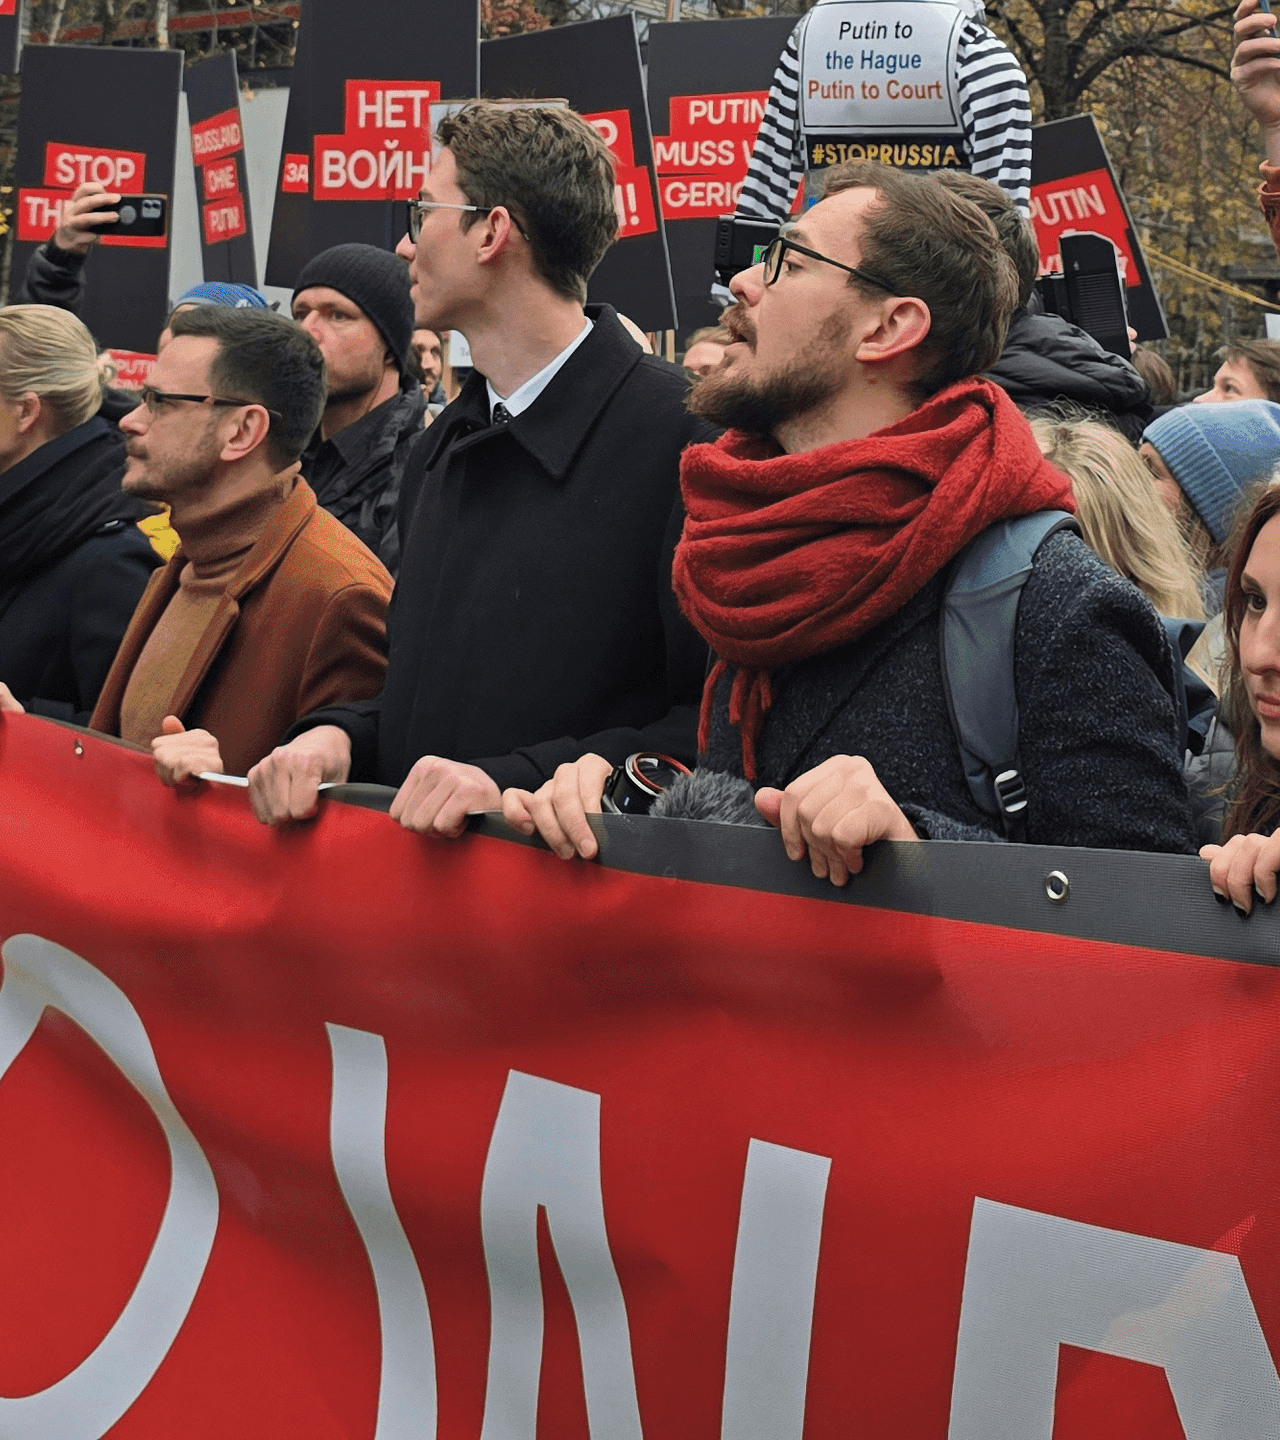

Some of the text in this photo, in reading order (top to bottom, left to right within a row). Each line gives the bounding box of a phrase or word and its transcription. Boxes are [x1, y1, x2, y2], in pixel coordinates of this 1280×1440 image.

[838, 20, 913, 40] Putin to
[825, 49, 922, 74] the Hague
[808, 78, 943, 100] Putin to Court
[357, 89, 430, 129] НЕТ
[689, 98, 769, 126] PUTIN
[322, 139, 431, 189] ВОЙН
[654, 139, 736, 167] MUSS
[811, 143, 962, 167] #STOPRUSSIA
[55, 151, 136, 188] STOP
[24, 195, 64, 228] TH
